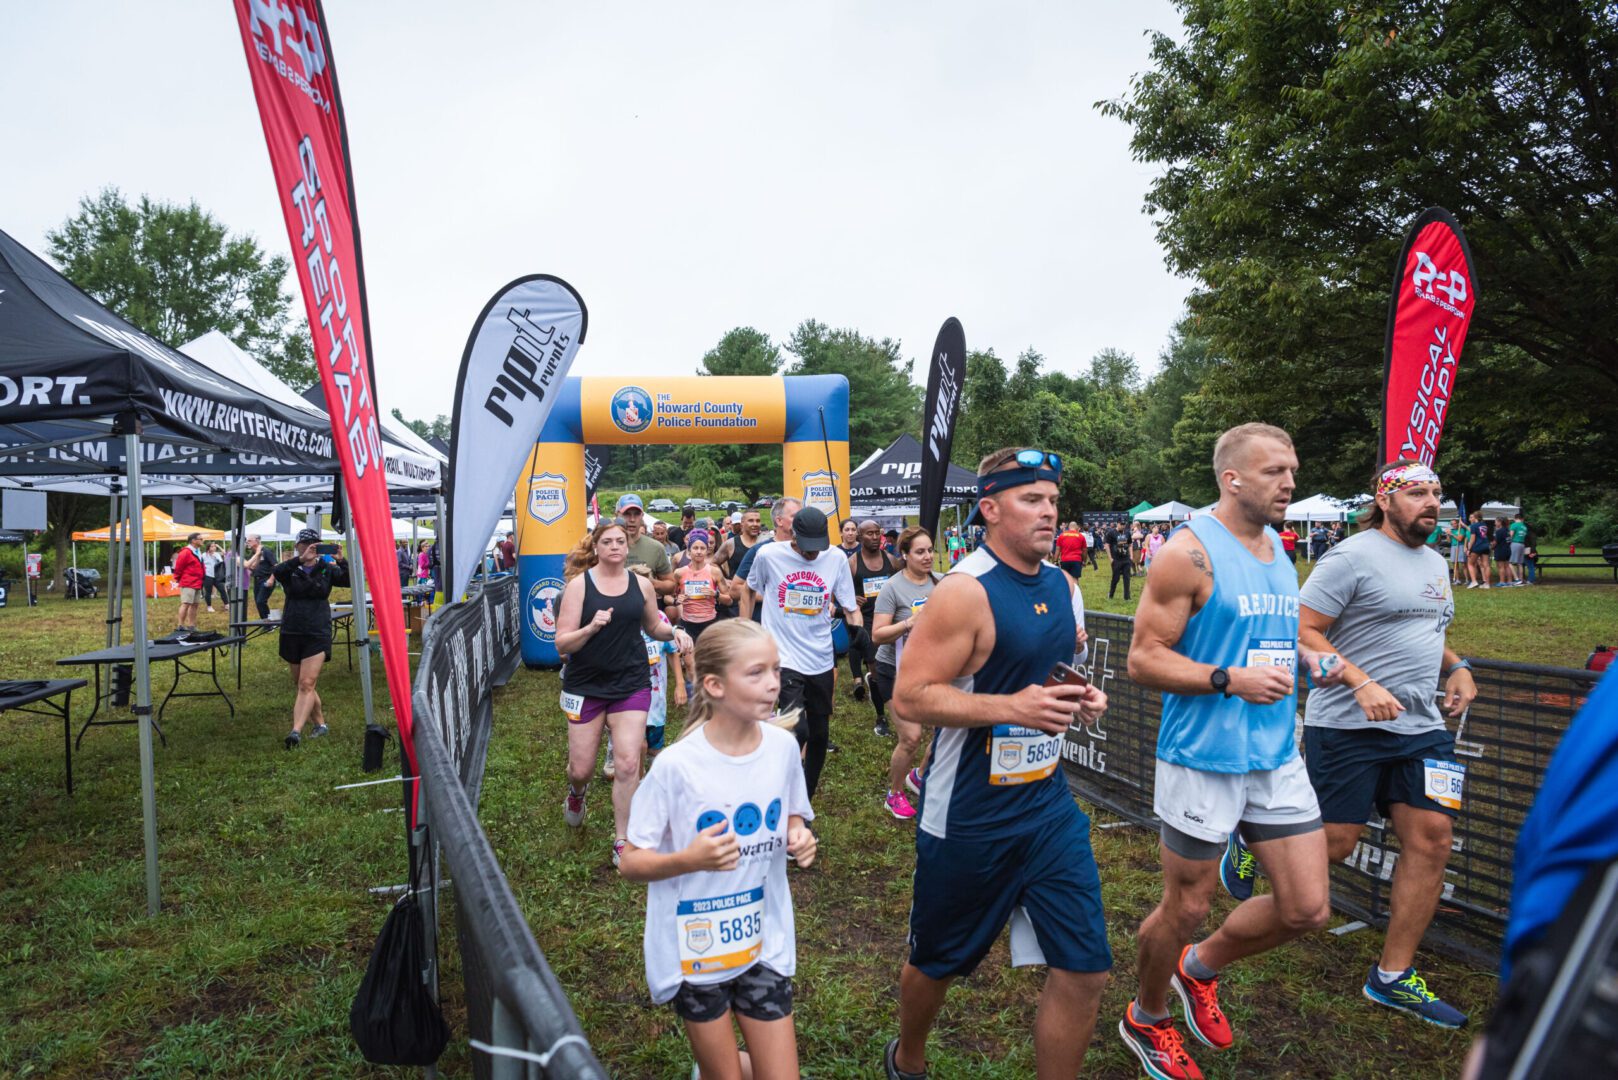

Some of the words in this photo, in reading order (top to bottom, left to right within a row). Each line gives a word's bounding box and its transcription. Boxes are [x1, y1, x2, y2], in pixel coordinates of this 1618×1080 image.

[298, 134, 384, 471] SPORTS
[290, 179, 369, 480] REHAB
[540, 332, 570, 387] events
[657, 393, 671, 401] THE
[657, 402, 701, 413] Howard
[703, 402, 743, 415] County
[158, 387, 333, 460] WWW.RIPITEVENTS.COM
[657, 416, 692, 427] Police
[694, 416, 757, 427] Foundation
[879, 485, 918, 495] TRAIL.
[802, 595, 823, 606] 5615
[1008, 727, 1026, 736] 2023
[1026, 738, 1060, 764] 5830
[693, 902, 712, 912] 2023
[711, 896, 735, 910] POLICE
[735, 892, 752, 905] PACE
[719, 911, 762, 945] 5835
